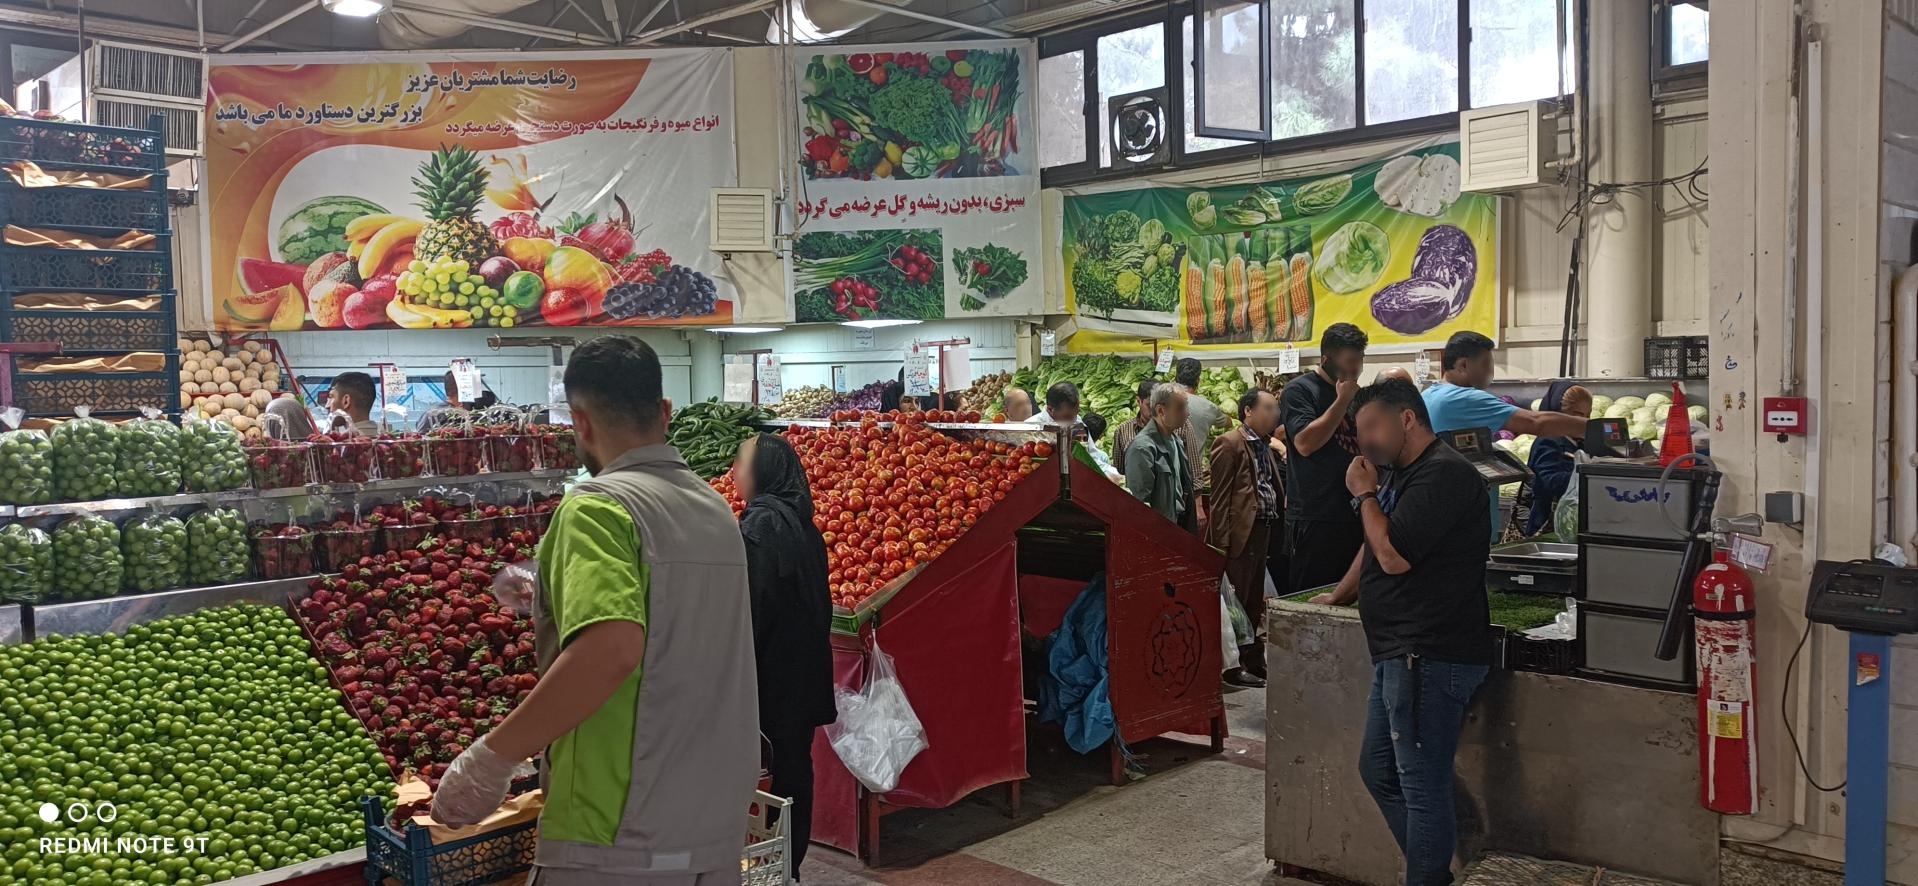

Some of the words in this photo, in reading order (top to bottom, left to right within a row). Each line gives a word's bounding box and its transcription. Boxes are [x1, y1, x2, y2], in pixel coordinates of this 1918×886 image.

[406, 74, 439, 93] عزیز
[441, 70, 499, 92] مشتریان
[500, 69, 526, 86] شما
[526, 69, 576, 90] رضایت
[215, 103, 248, 124] باشد
[251, 110, 275, 125] می
[278, 103, 293, 119] ما
[295, 102, 354, 124] دستاورد
[357, 101, 422, 124] بزرگترین
[485, 120, 515, 136] عرضه
[560, 120, 594, 135] صورت
[596, 119, 607, 133] به
[660, 120, 667, 132] و
[668, 119, 691, 132] میوه
[692, 115, 719, 132] انواع
[798, 197, 828, 219] گردد
[829, 202, 851, 218] می
[850, 196, 887, 217] عرضه
[887, 194, 908, 216] گل
[908, 200, 917, 216] و
[917, 193, 949, 214] ریشه
[949, 195, 983, 214] بدون
